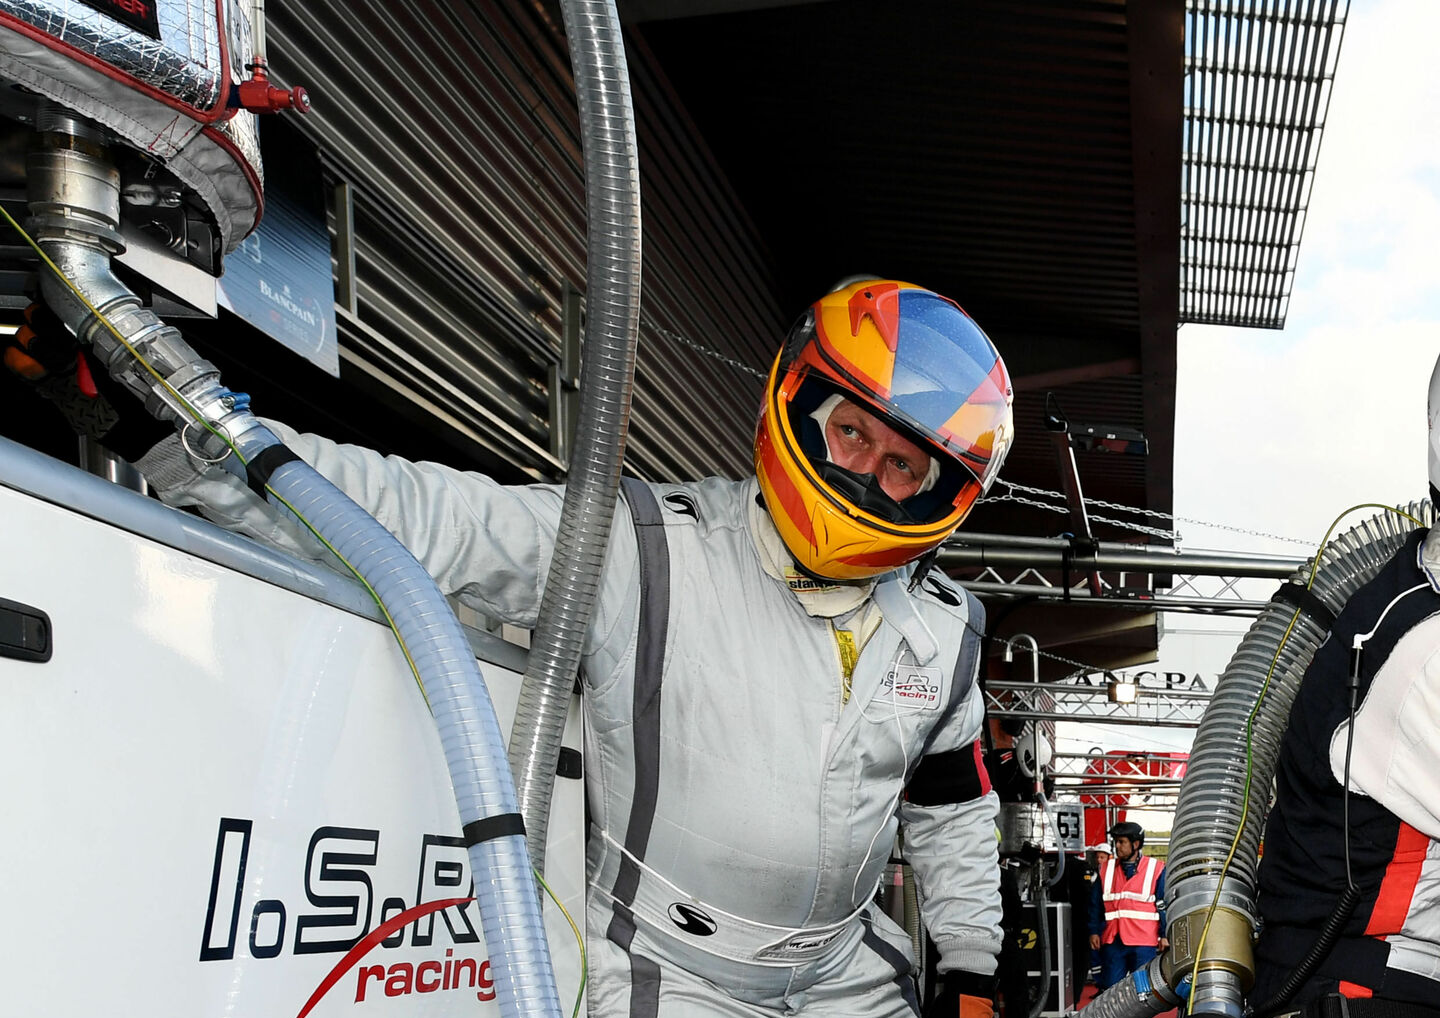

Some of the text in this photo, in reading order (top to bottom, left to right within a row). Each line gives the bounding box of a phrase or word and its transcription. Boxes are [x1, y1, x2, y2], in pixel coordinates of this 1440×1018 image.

[895, 690, 935, 701] racing
[1057, 811, 1081, 839] 63
[353, 949, 497, 1004] racing
